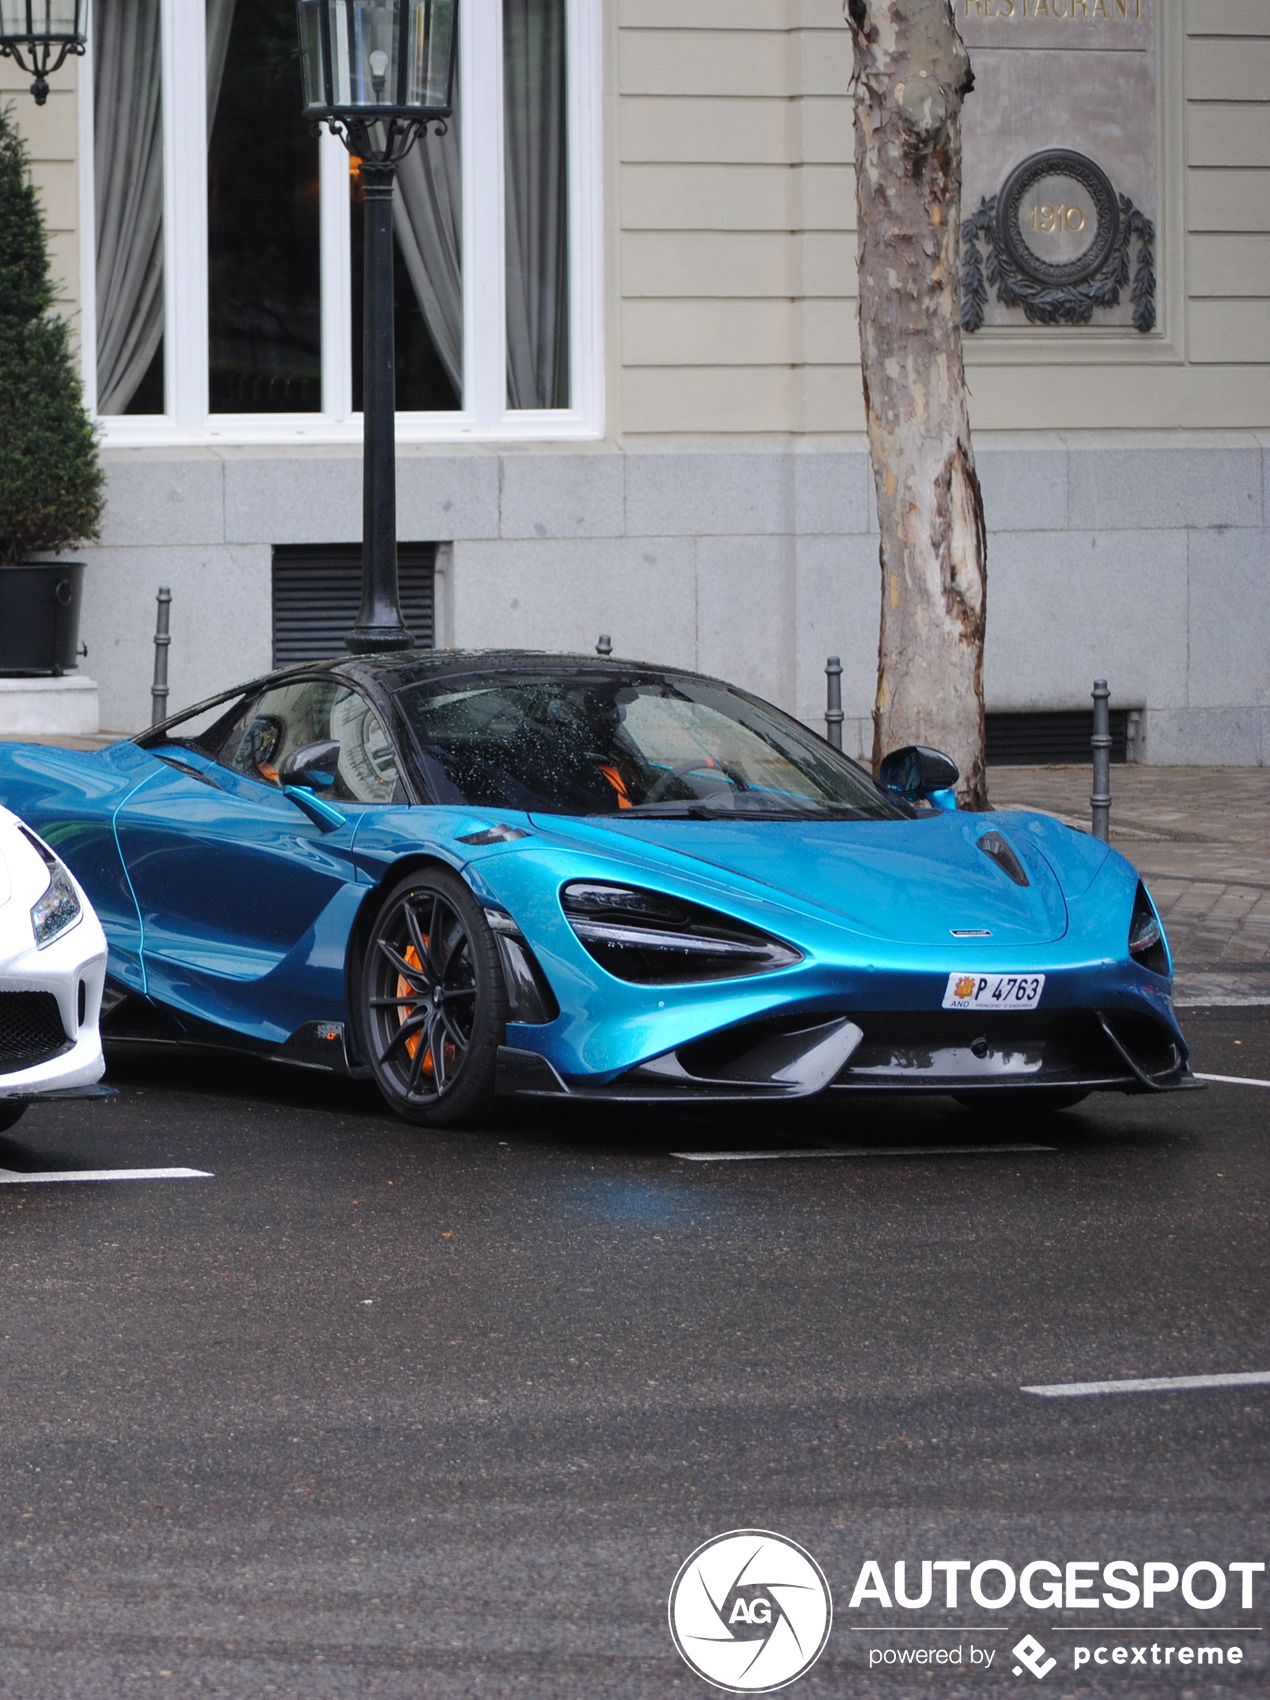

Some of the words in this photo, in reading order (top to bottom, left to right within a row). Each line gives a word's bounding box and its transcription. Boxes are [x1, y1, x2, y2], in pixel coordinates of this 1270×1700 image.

[964, 0, 1144, 19] RESTAURANT
[1031, 204, 1085, 233] 1910
[974, 978, 988, 1001] P
[991, 978, 1040, 1001] 4763
[950, 1000, 970, 1008] AND
